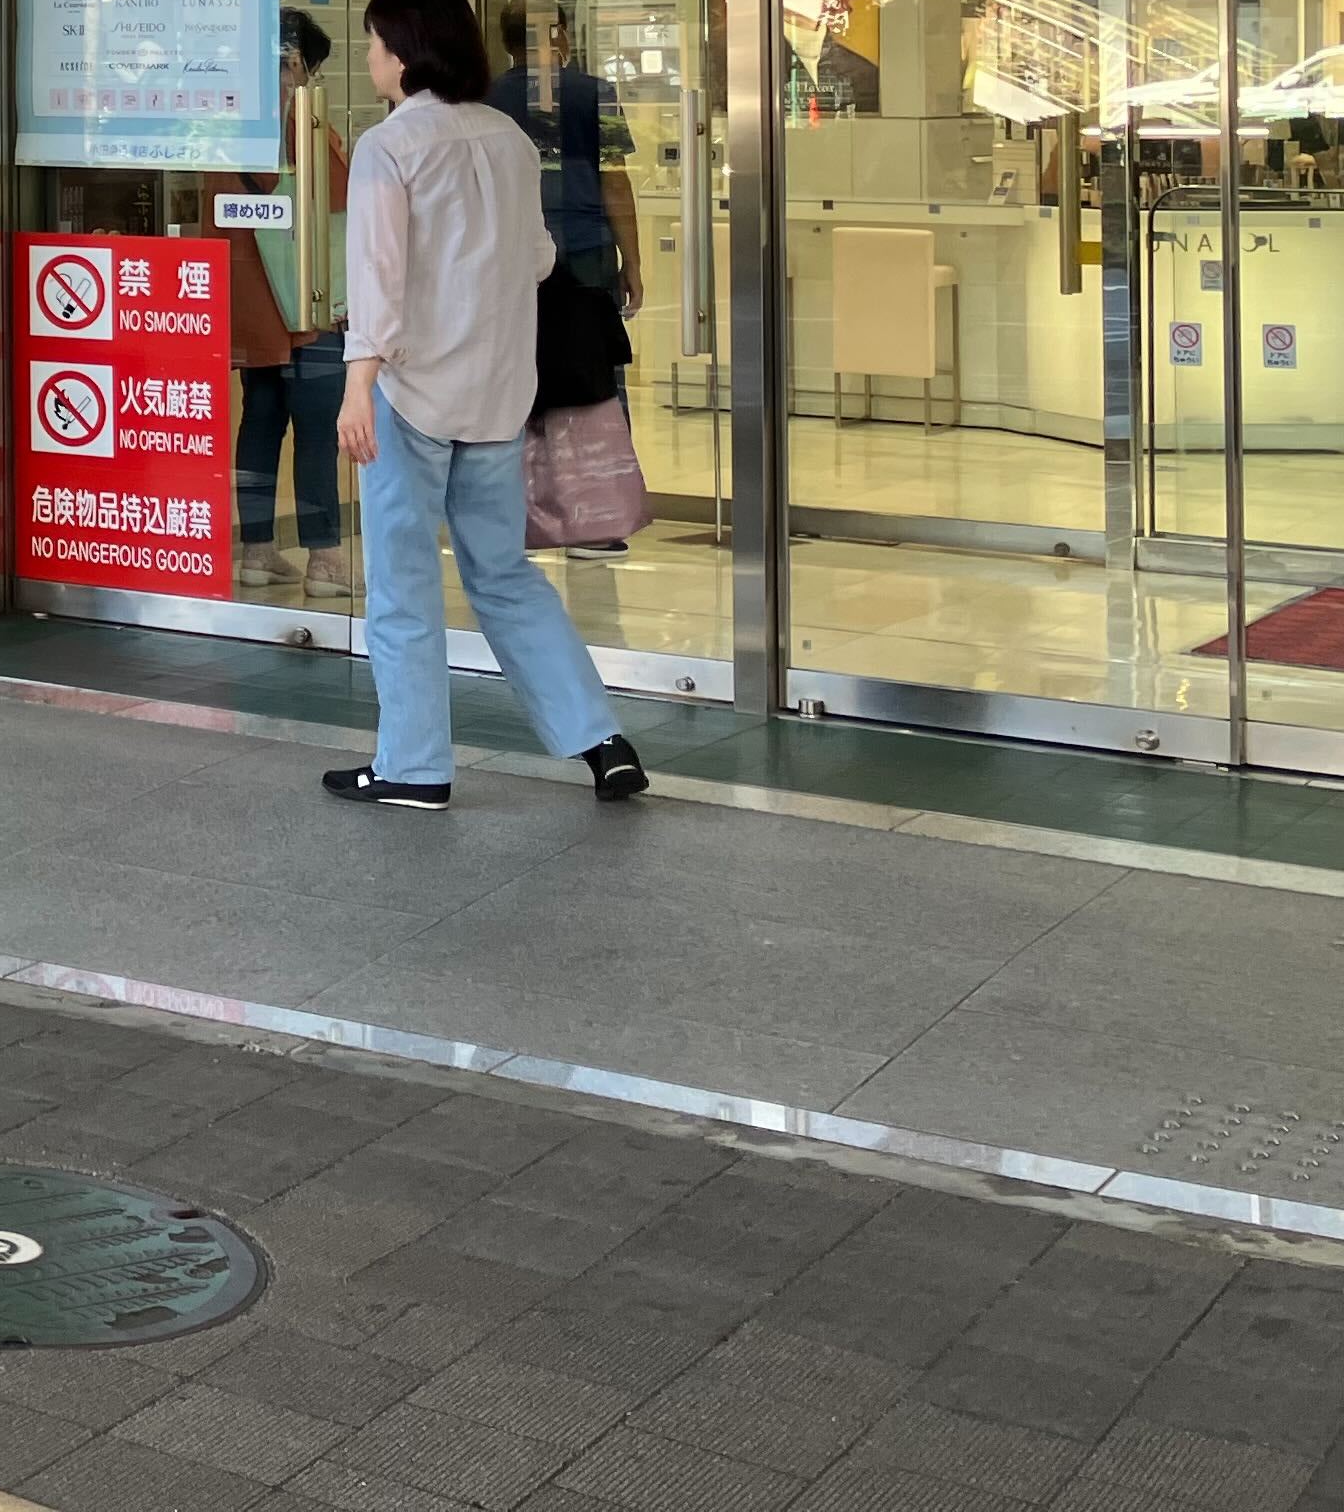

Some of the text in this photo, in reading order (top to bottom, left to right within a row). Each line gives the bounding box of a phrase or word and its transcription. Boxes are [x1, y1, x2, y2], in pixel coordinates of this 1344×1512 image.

[111, 21, 167, 33] SHISEIDO
[223, 202, 284, 220] 締め切り
[119, 259, 211, 300] 禁煙
[119, 309, 211, 335] NO SMOKING
[119, 376, 213, 420] 火気厳禁
[119, 428, 213, 456] NO OPEN FLAME
[31, 484, 213, 540] 危険物品持込厳禁
[31, 536, 213, 576] NO DANGEROUS GOODS
